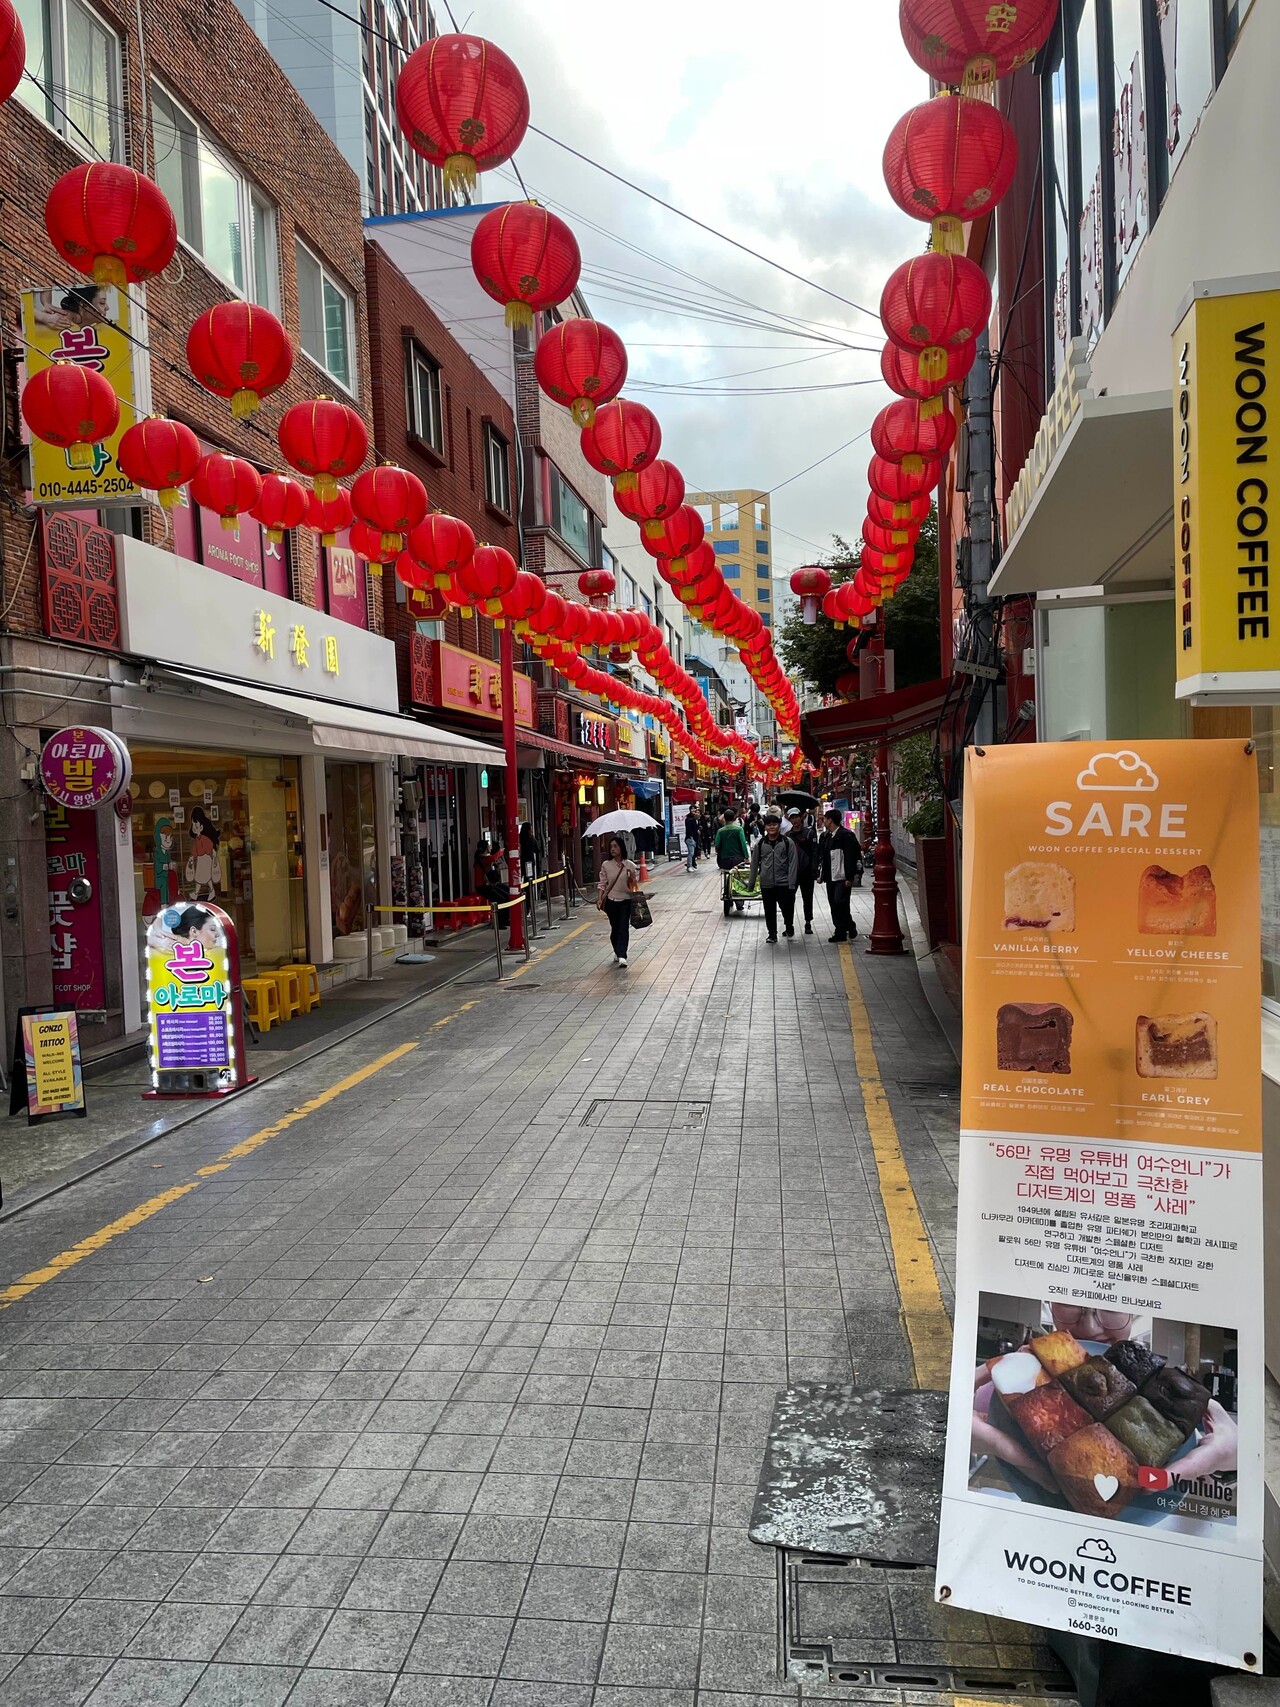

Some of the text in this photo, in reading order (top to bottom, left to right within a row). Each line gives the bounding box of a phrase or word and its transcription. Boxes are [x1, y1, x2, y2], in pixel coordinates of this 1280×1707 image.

[39, 477, 134, 497] 010-4445-2504
[1235, 321, 1270, 640] WOON COFFEE
[1178, 341, 1193, 652] WOON COFFEE
[207, 544, 260, 575] AROMA FOOT SHOP
[51, 743, 106, 759] 아로마
[62, 759, 97, 792] 발
[1045, 801, 1187, 838] SARE
[1028, 845, 1202, 856] WOON COFFEE SPECIAL DESSERT
[993, 943, 1080, 954] VANILLA BERRY
[1126, 948, 1229, 960] YELLOW CHEESE
[165, 939, 213, 983] 본
[73, 983, 91, 992] SHOP
[154, 982, 228, 1010] 아로마
[39, 1024, 63, 1034] GONZO
[40, 1038, 65, 1048] TATTOO
[983, 1083, 1085, 1096] REAL CHOCOLATE
[1141, 1092, 1210, 1106] EARL GREY
[989, 1142, 1231, 1179] “56만 유명 유튜버 여수언니”가
[1024, 1164, 1188, 1195] 직접 먹어보고 극찬한
[1017, 1182, 1096, 1205] 디저트계의
[1104, 1191, 1137, 1209] 명품
[1018, 1205, 1051, 1216] 1949년에
[1054, 1209, 1076, 1219] 설립된
[1113, 1216, 1145, 1227] 일본유명
[1149, 1220, 1197, 1234] 조리제과학교
[1044, 1229, 1074, 1241] 연구하고
[1078, 1234, 1101, 1244] 개발한
[1140, 1242, 1163, 1252] 디저트
[1086, 1224, 1102, 1233] 유명
[1141, 1230, 1173, 1242] 본인만의
[1204, 1238, 1238, 1251] 레시피로
[1024, 1238, 1041, 1247] 56만
[1045, 1240, 1060, 1250] 유명
[1064, 1243, 1086, 1253] 유튜버
[1140, 1252, 1165, 1263] 극찬한
[1168, 1256, 1193, 1267] 작지만
[1066, 1255, 1104, 1267] 디저트계의
[1108, 1259, 1124, 1269] 명품
[1014, 1258, 1044, 1270] 디저트에
[1047, 1262, 1070, 1273] 진심인
[1073, 1266, 1104, 1278] 까다로운
[1121, 1296, 1162, 1310] 만나보세요
[1171, 1472, 1233, 1502] YouTube
[1156, 1497, 1231, 1520] 여수언니정혜영
[1004, 1549, 1192, 1606] WOON COFFEE
[1037, 1581, 1069, 1593] SOMTHING
[1070, 1588, 1095, 1599] BETTER,
[1095, 1594, 1110, 1602] GIVE
[1122, 1599, 1150, 1610] LOOKING
[1151, 1605, 1175, 1615] BETTER
[1077, 1601, 1121, 1615] WOONCOFFEE
[1067, 1618, 1118, 1637] 1660-3601
